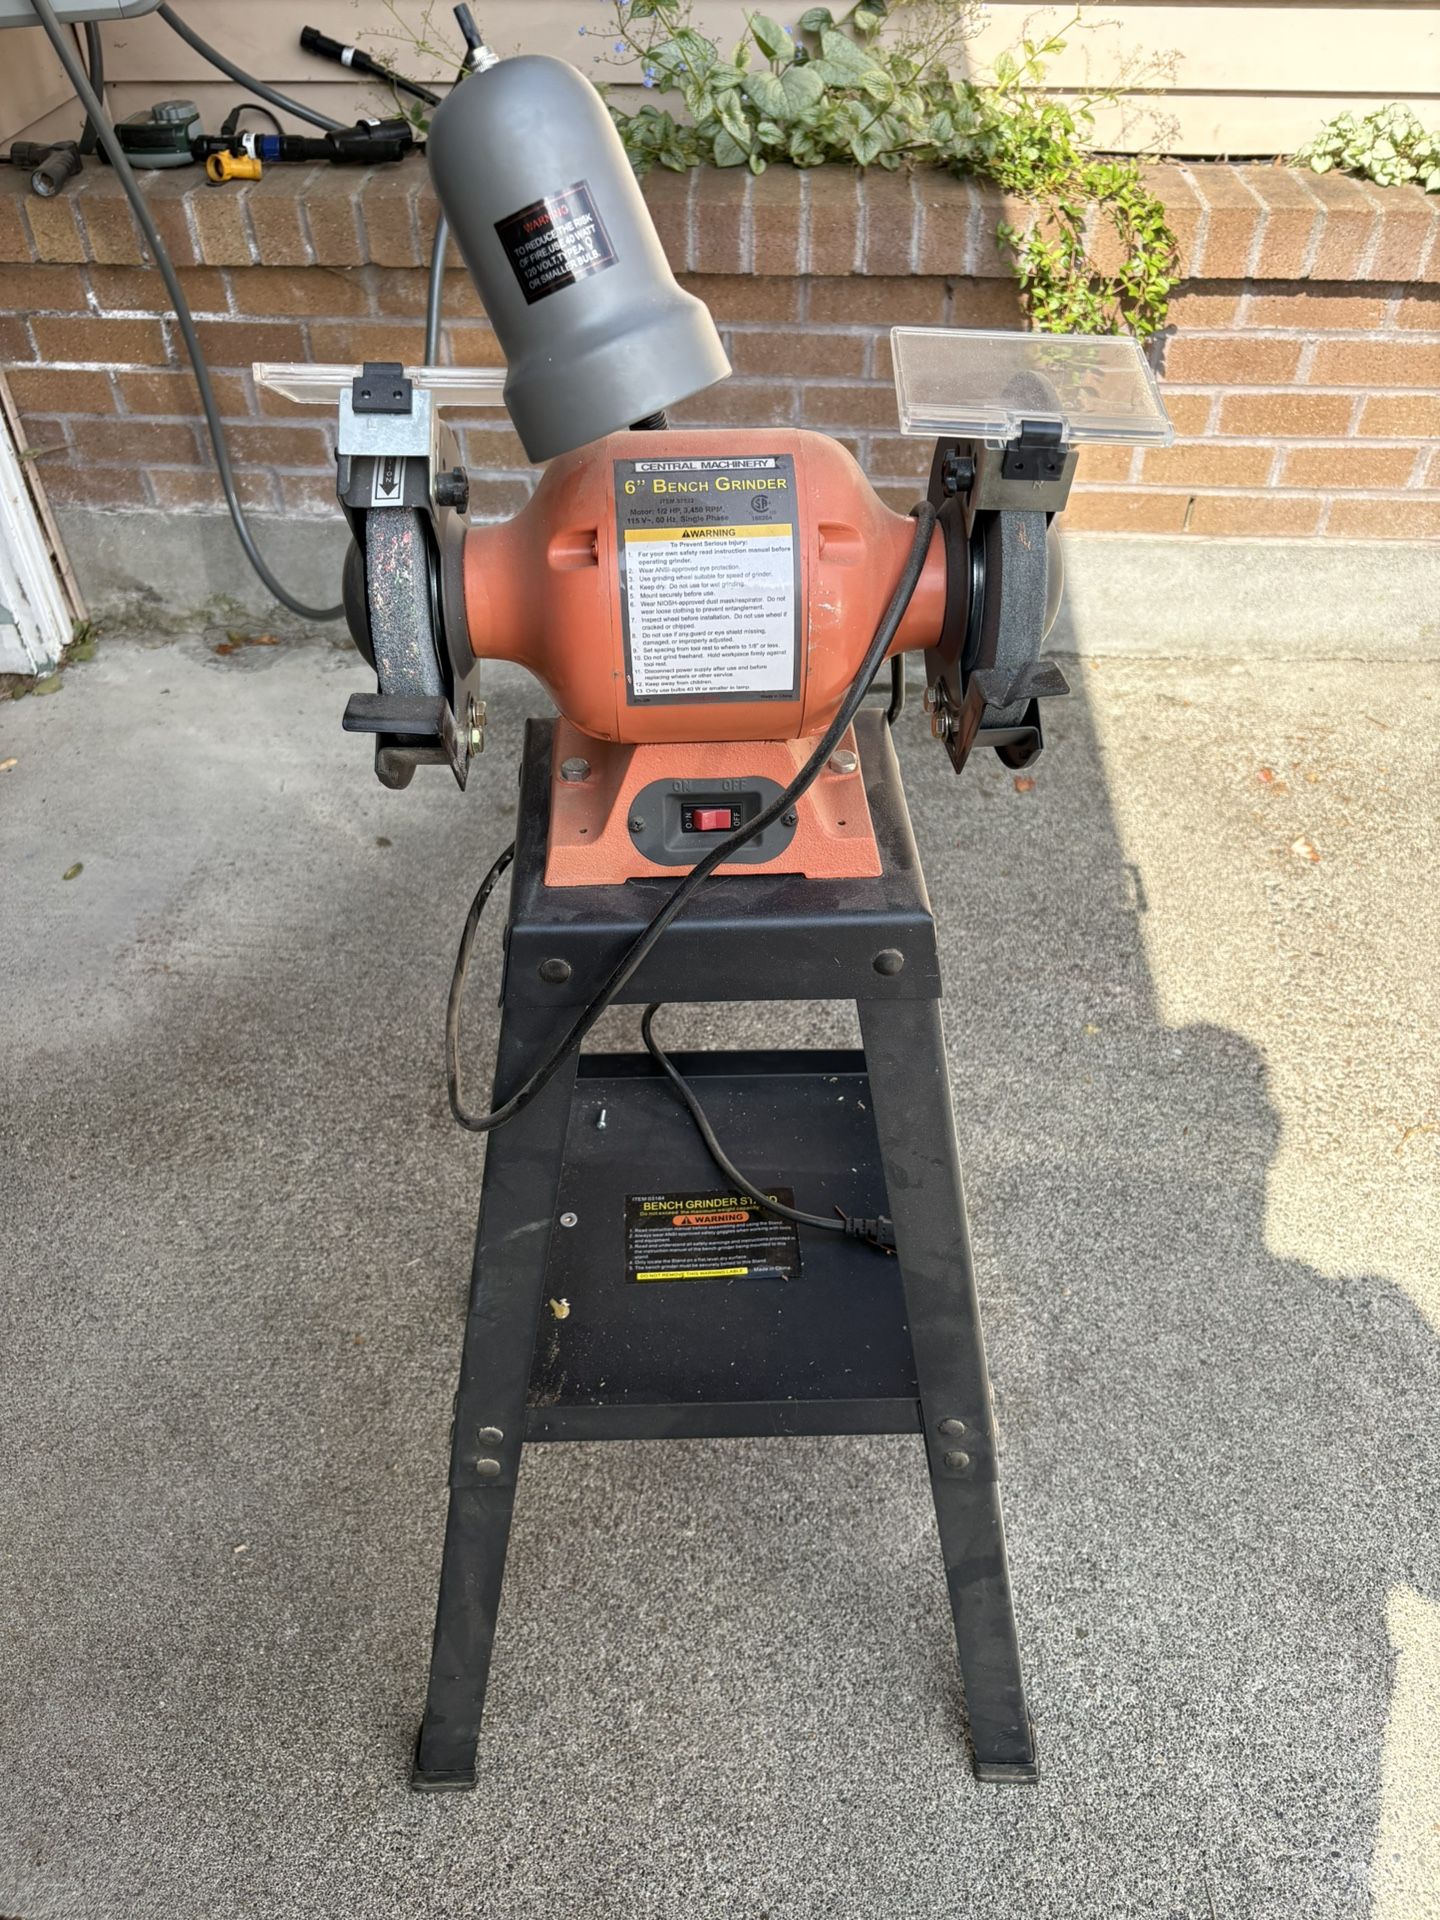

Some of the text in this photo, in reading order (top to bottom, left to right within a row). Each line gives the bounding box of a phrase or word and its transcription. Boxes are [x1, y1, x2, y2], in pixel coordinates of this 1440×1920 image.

[514, 246, 525, 256] TO
[524, 230, 557, 250] REDUCE
[556, 222, 573, 235] THE
[518, 256, 530, 267] OF
[565, 235, 575, 244] 40
[575, 225, 596, 239] WATT
[524, 267, 537, 278] 120
[528, 248, 600, 289] OR SMALLER BULB.
[641, 460, 768, 470] CENTRAL MACHINERY
[653, 479, 708, 494] BENCH
[715, 476, 788, 491] GRINDER
[680, 515, 704, 524] Single
[690, 528, 736, 538] WARNING
[652, 574, 674, 582] grinding
[672, 624, 695, 632] chipped.
[672, 780, 747, 792] ON OFF
[643, 1200, 683, 1210] BENCH
[685, 1198, 738, 1209] GRINDER
[695, 1214, 743, 1222] WARNING
